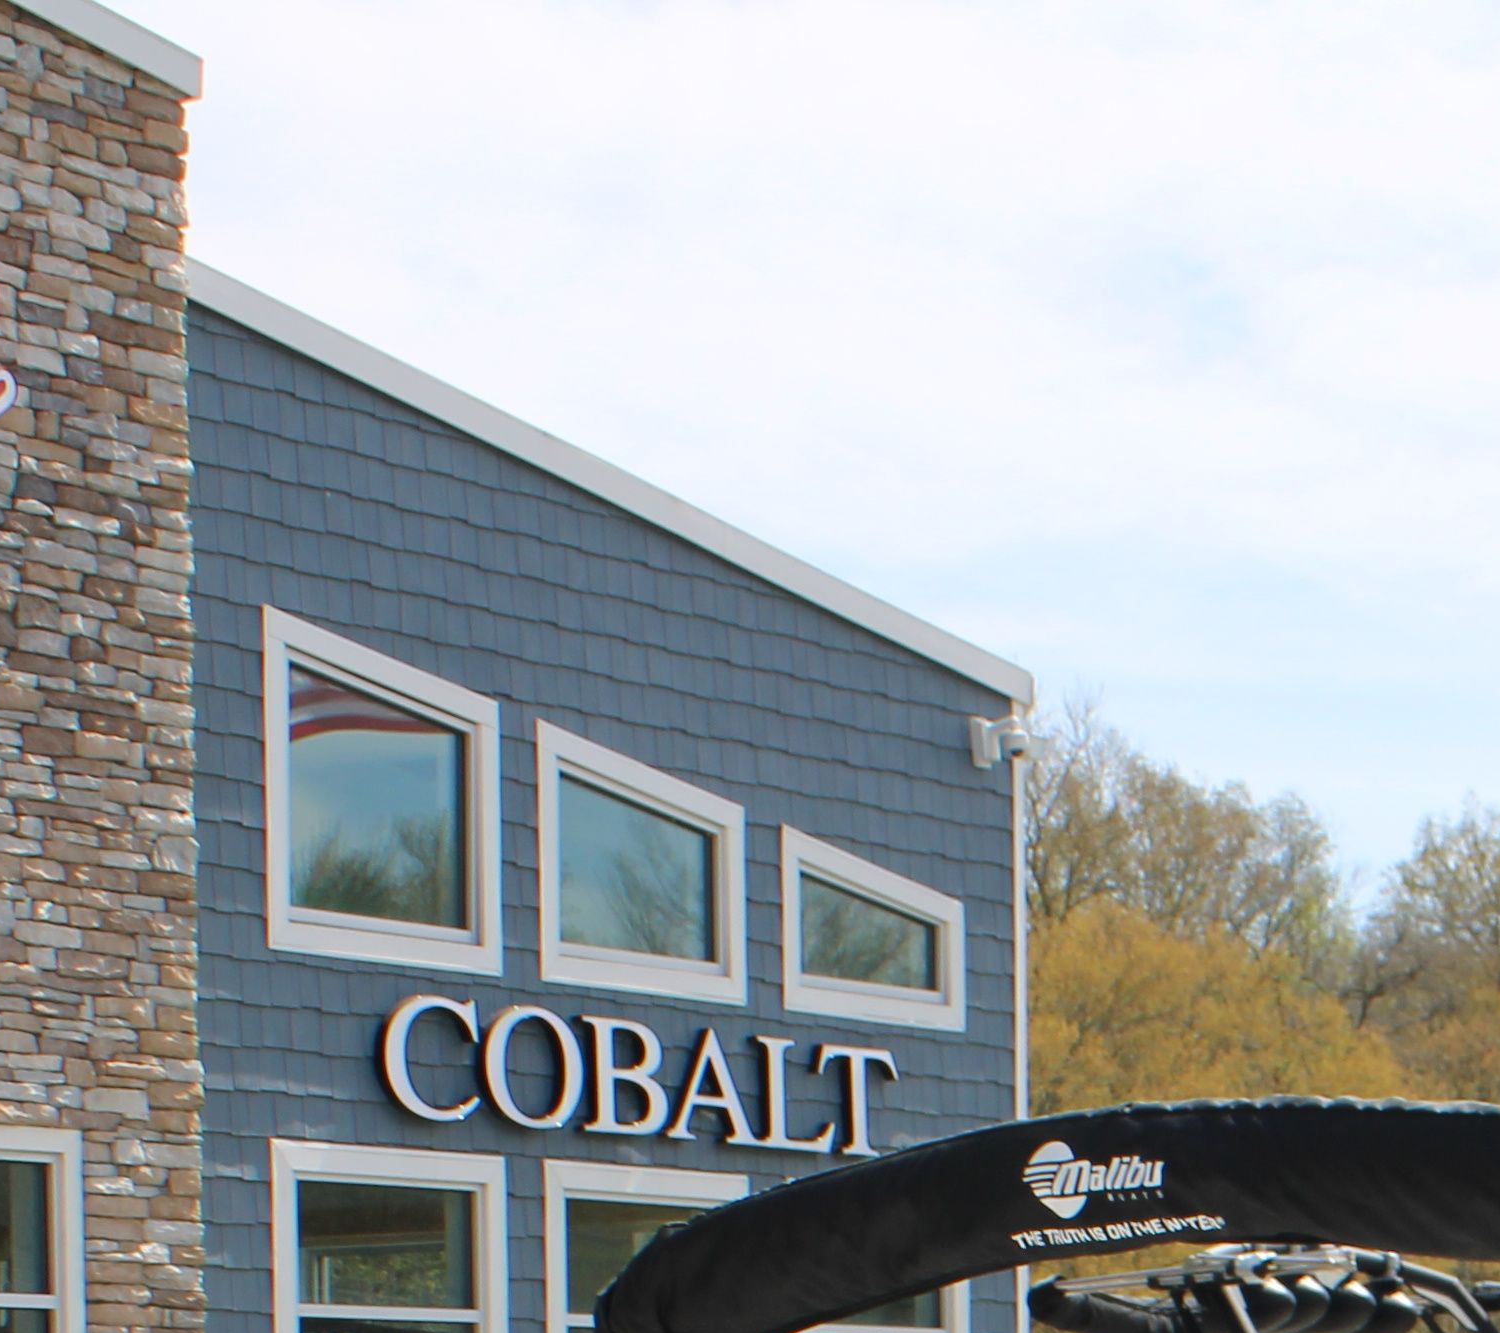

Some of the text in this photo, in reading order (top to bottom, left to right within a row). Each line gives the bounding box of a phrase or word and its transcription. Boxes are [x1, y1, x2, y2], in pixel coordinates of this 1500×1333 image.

[384, 993, 900, 1158] COBALT
[1052, 1155, 1165, 1196] Malibu
[1011, 1230, 1046, 1249] THE
[1043, 1226, 1091, 1246] TRUTH
[1086, 1226, 1108, 1241] IS
[1105, 1221, 1133, 1240] ON
[1130, 1218, 1167, 1236] THE
